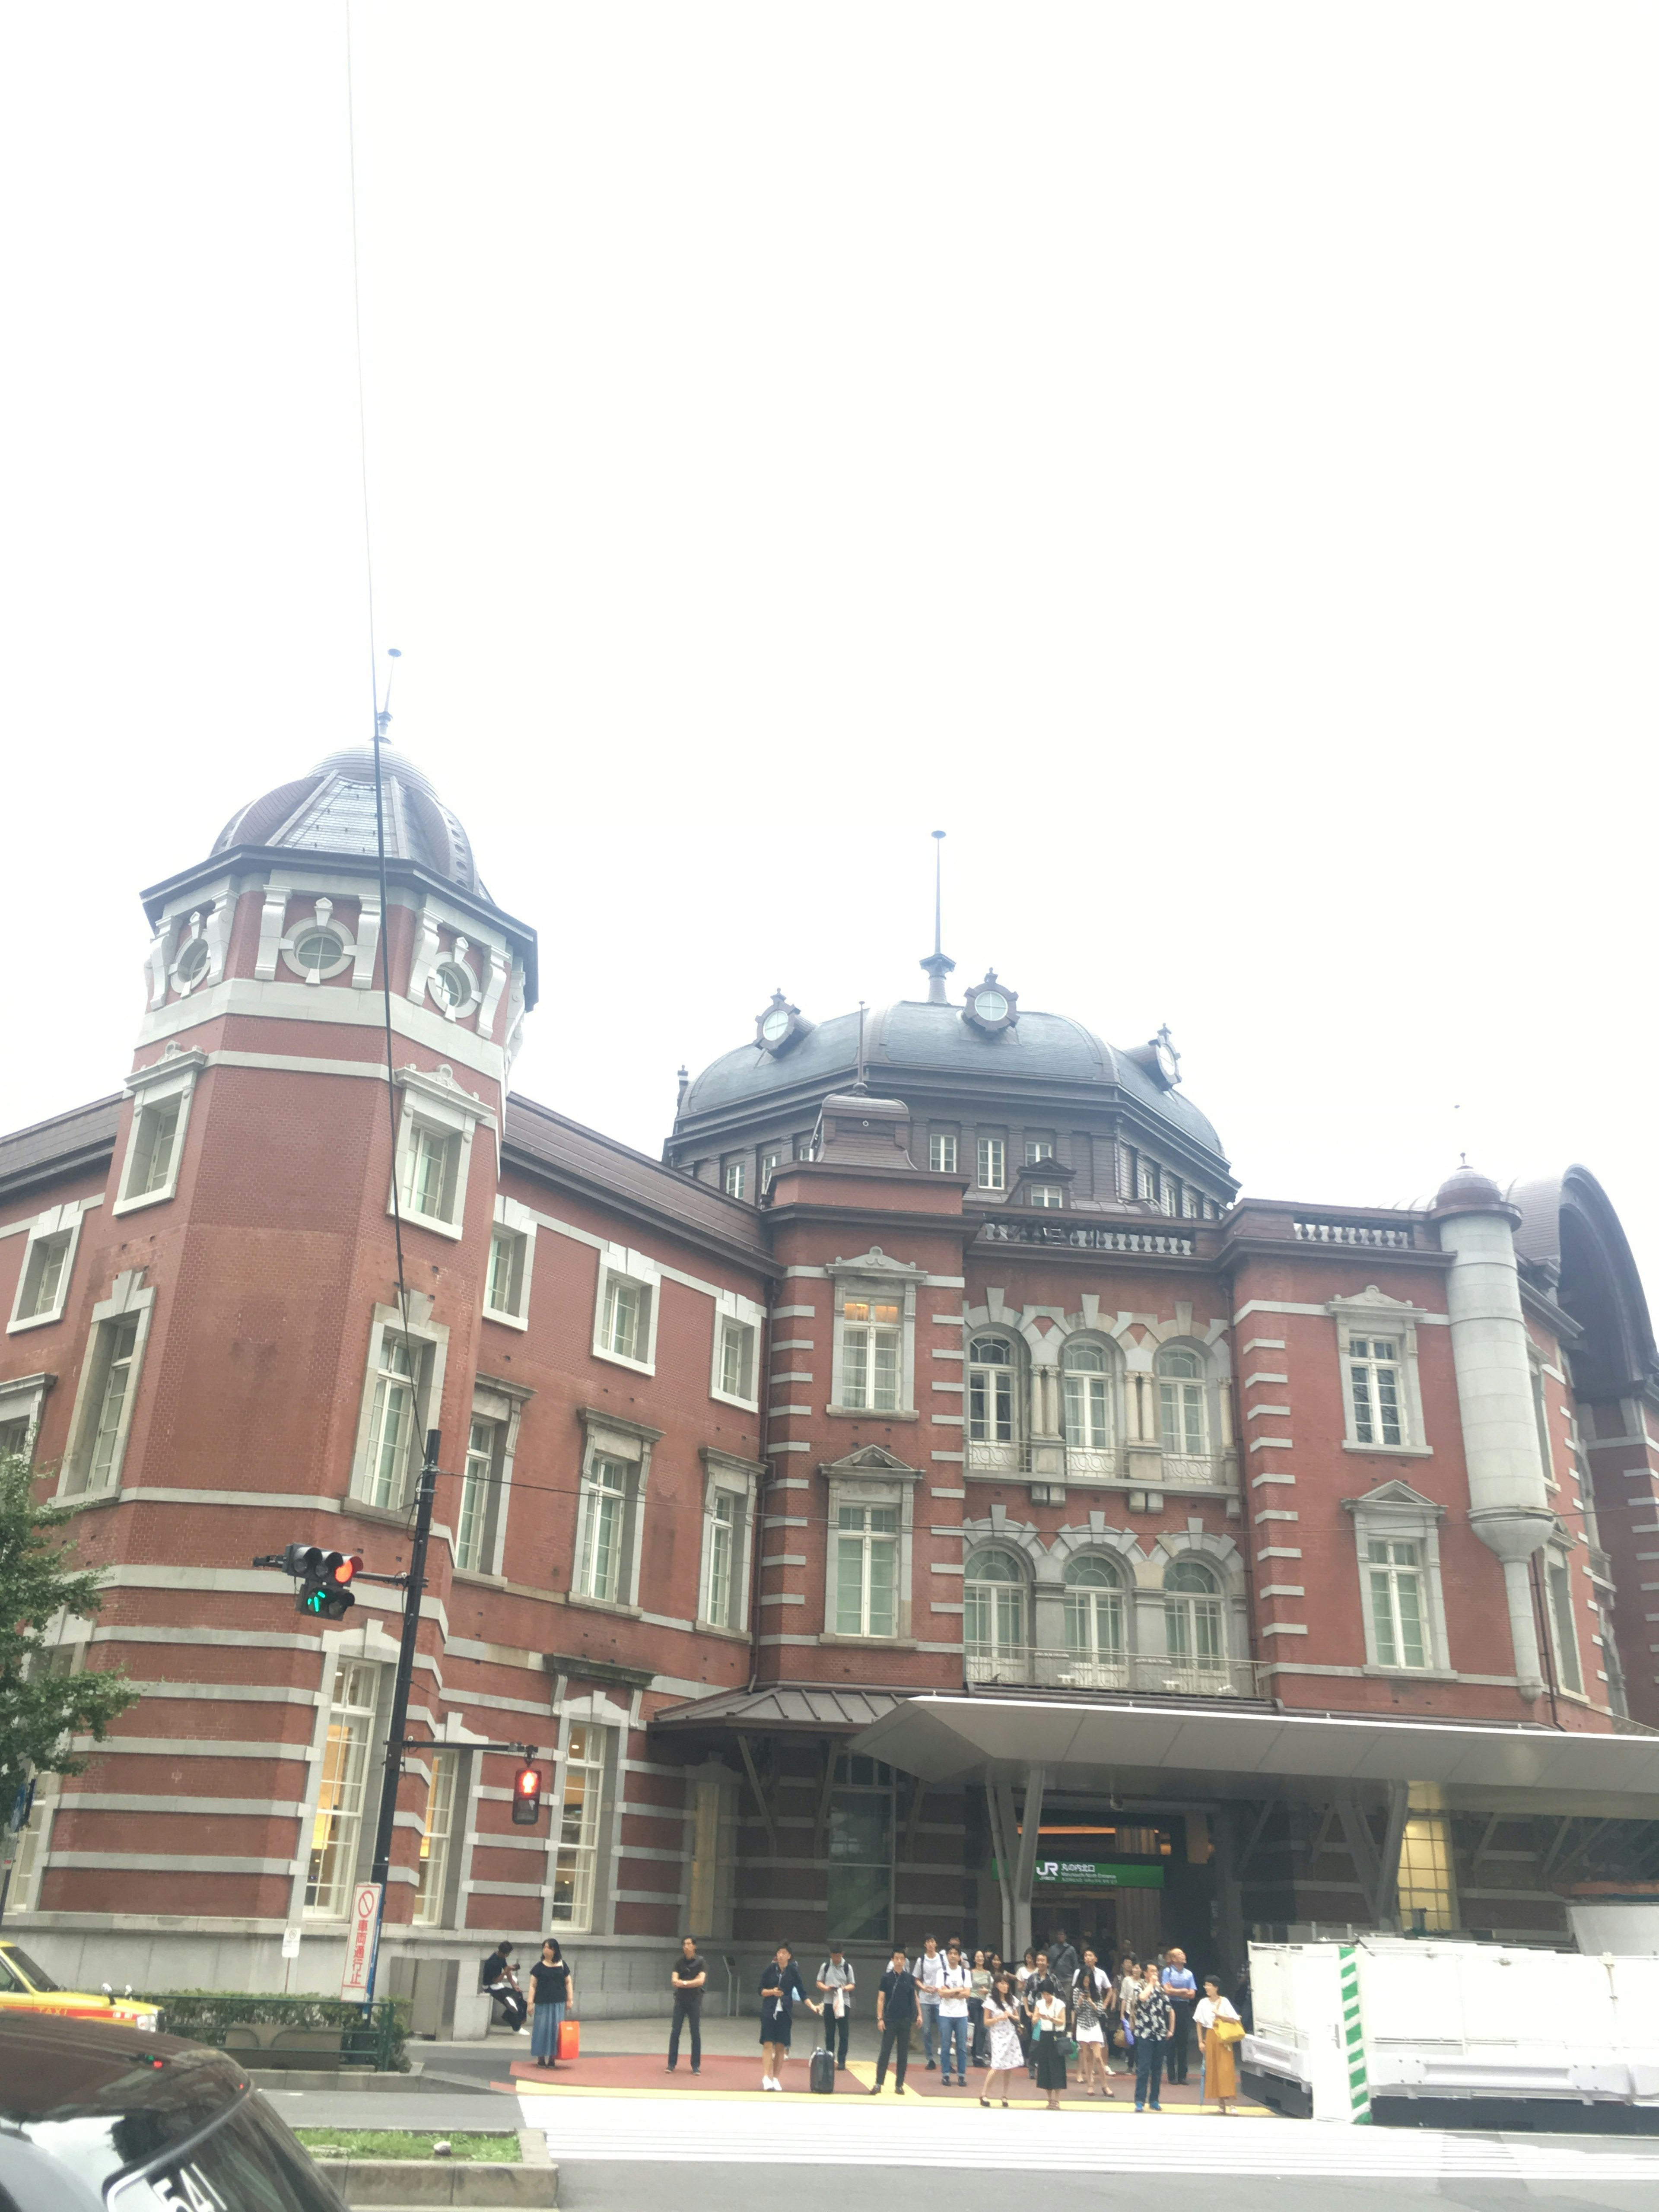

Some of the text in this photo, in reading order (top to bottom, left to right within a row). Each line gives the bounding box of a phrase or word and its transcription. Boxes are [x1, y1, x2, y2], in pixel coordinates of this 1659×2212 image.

[1036, 1862, 1058, 1876] JR
[350, 1920, 369, 1985] 車両通行止
